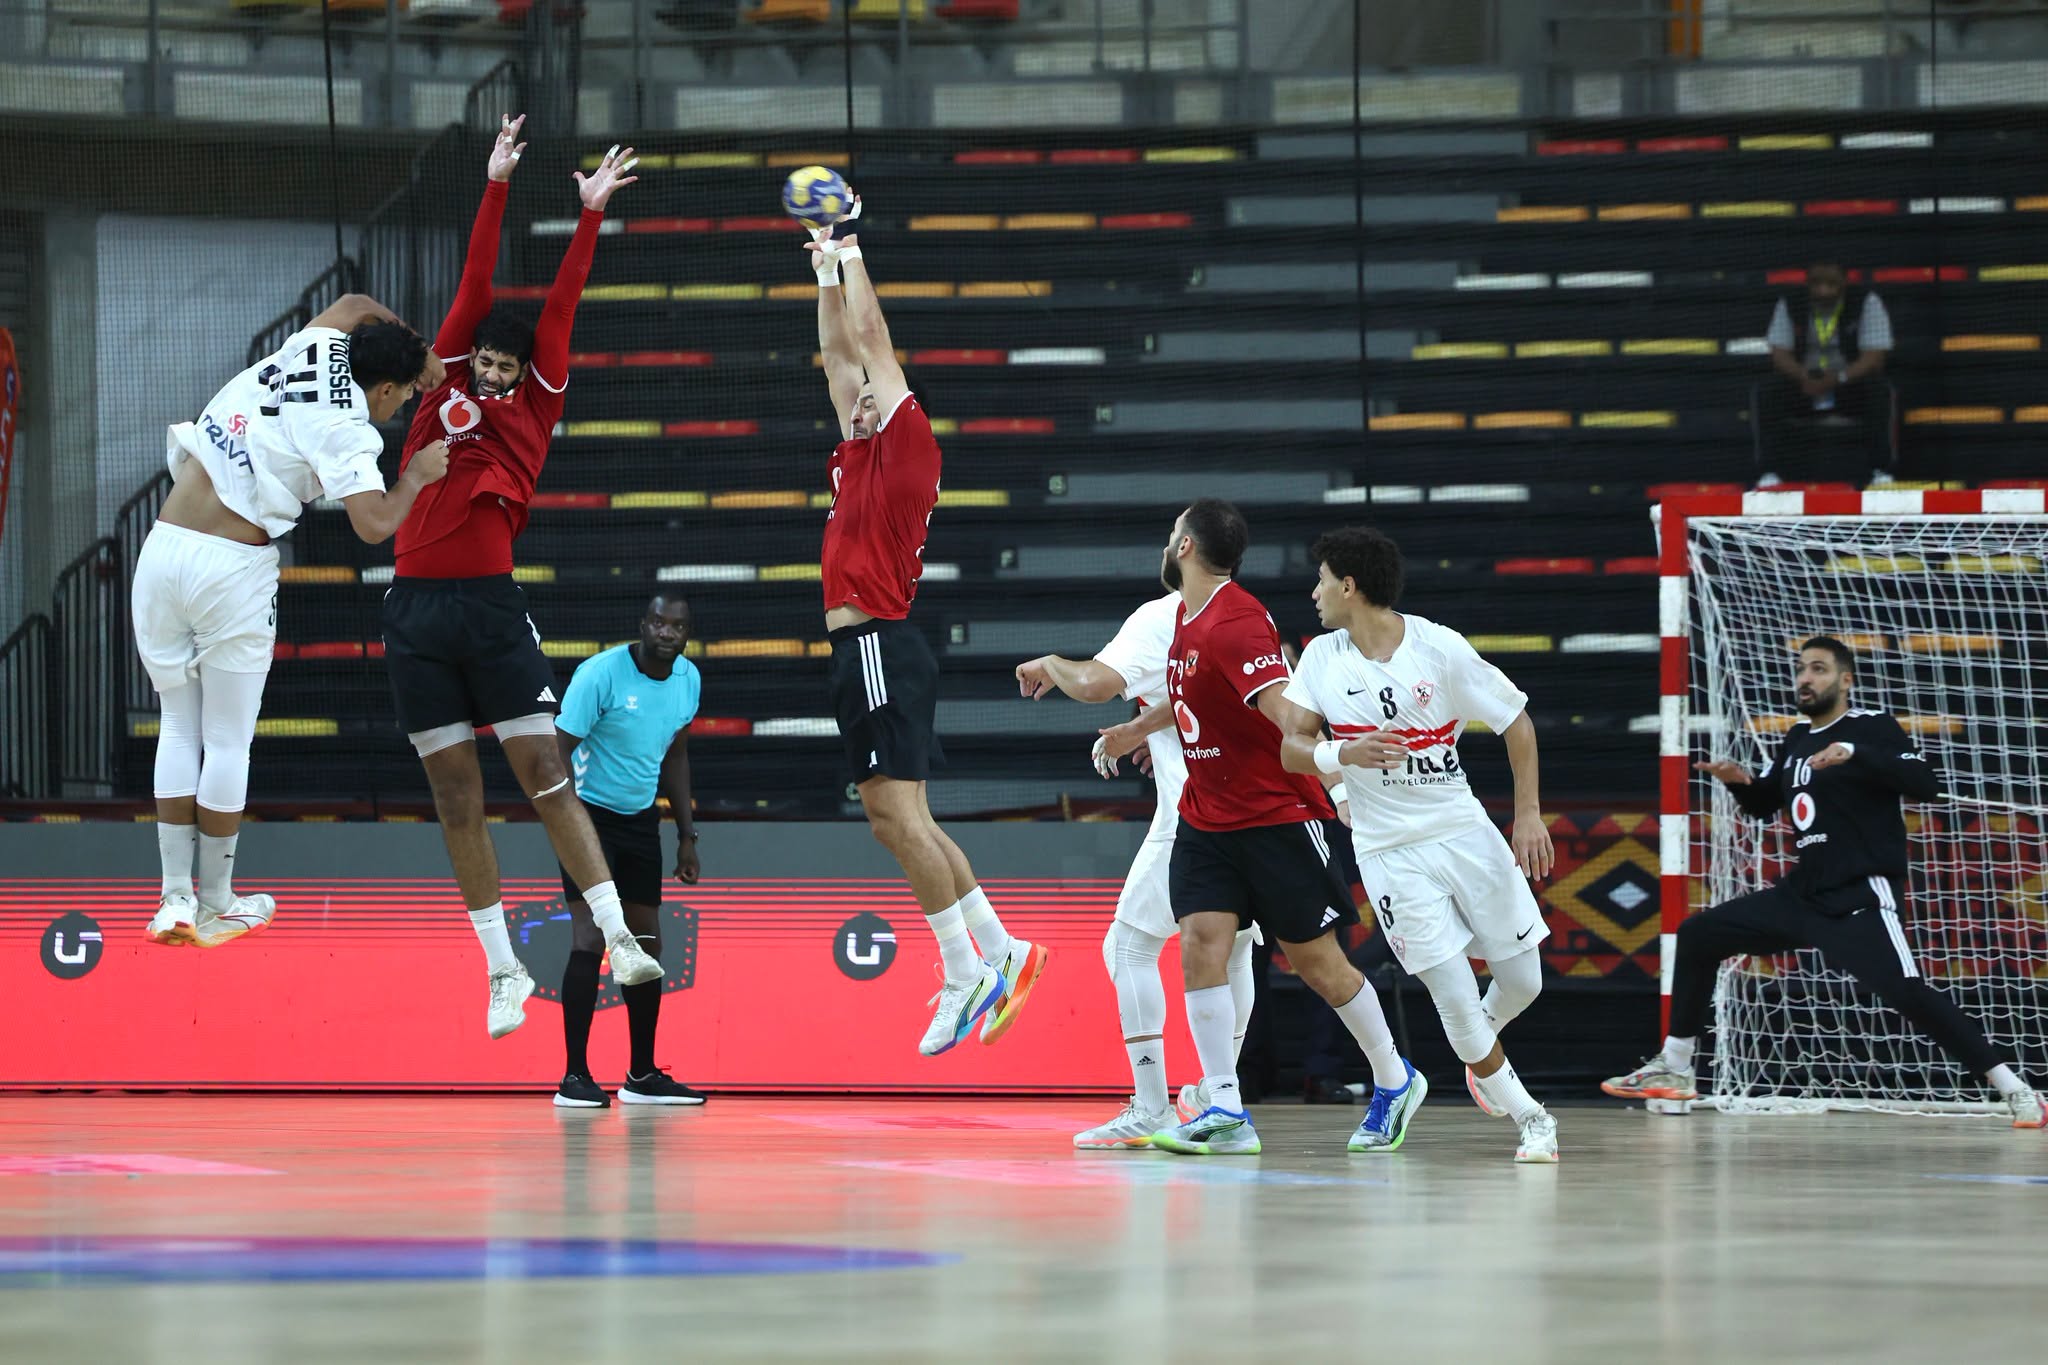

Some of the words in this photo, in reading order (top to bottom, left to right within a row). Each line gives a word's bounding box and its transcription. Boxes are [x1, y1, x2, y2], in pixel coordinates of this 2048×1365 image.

[328, 334, 353, 410] YOUSSEF
[1378, 686, 1398, 720] 8
[1183, 746, 1221, 760] afone
[1791, 755, 1813, 788] 16
[1378, 894, 1395, 931] 8
